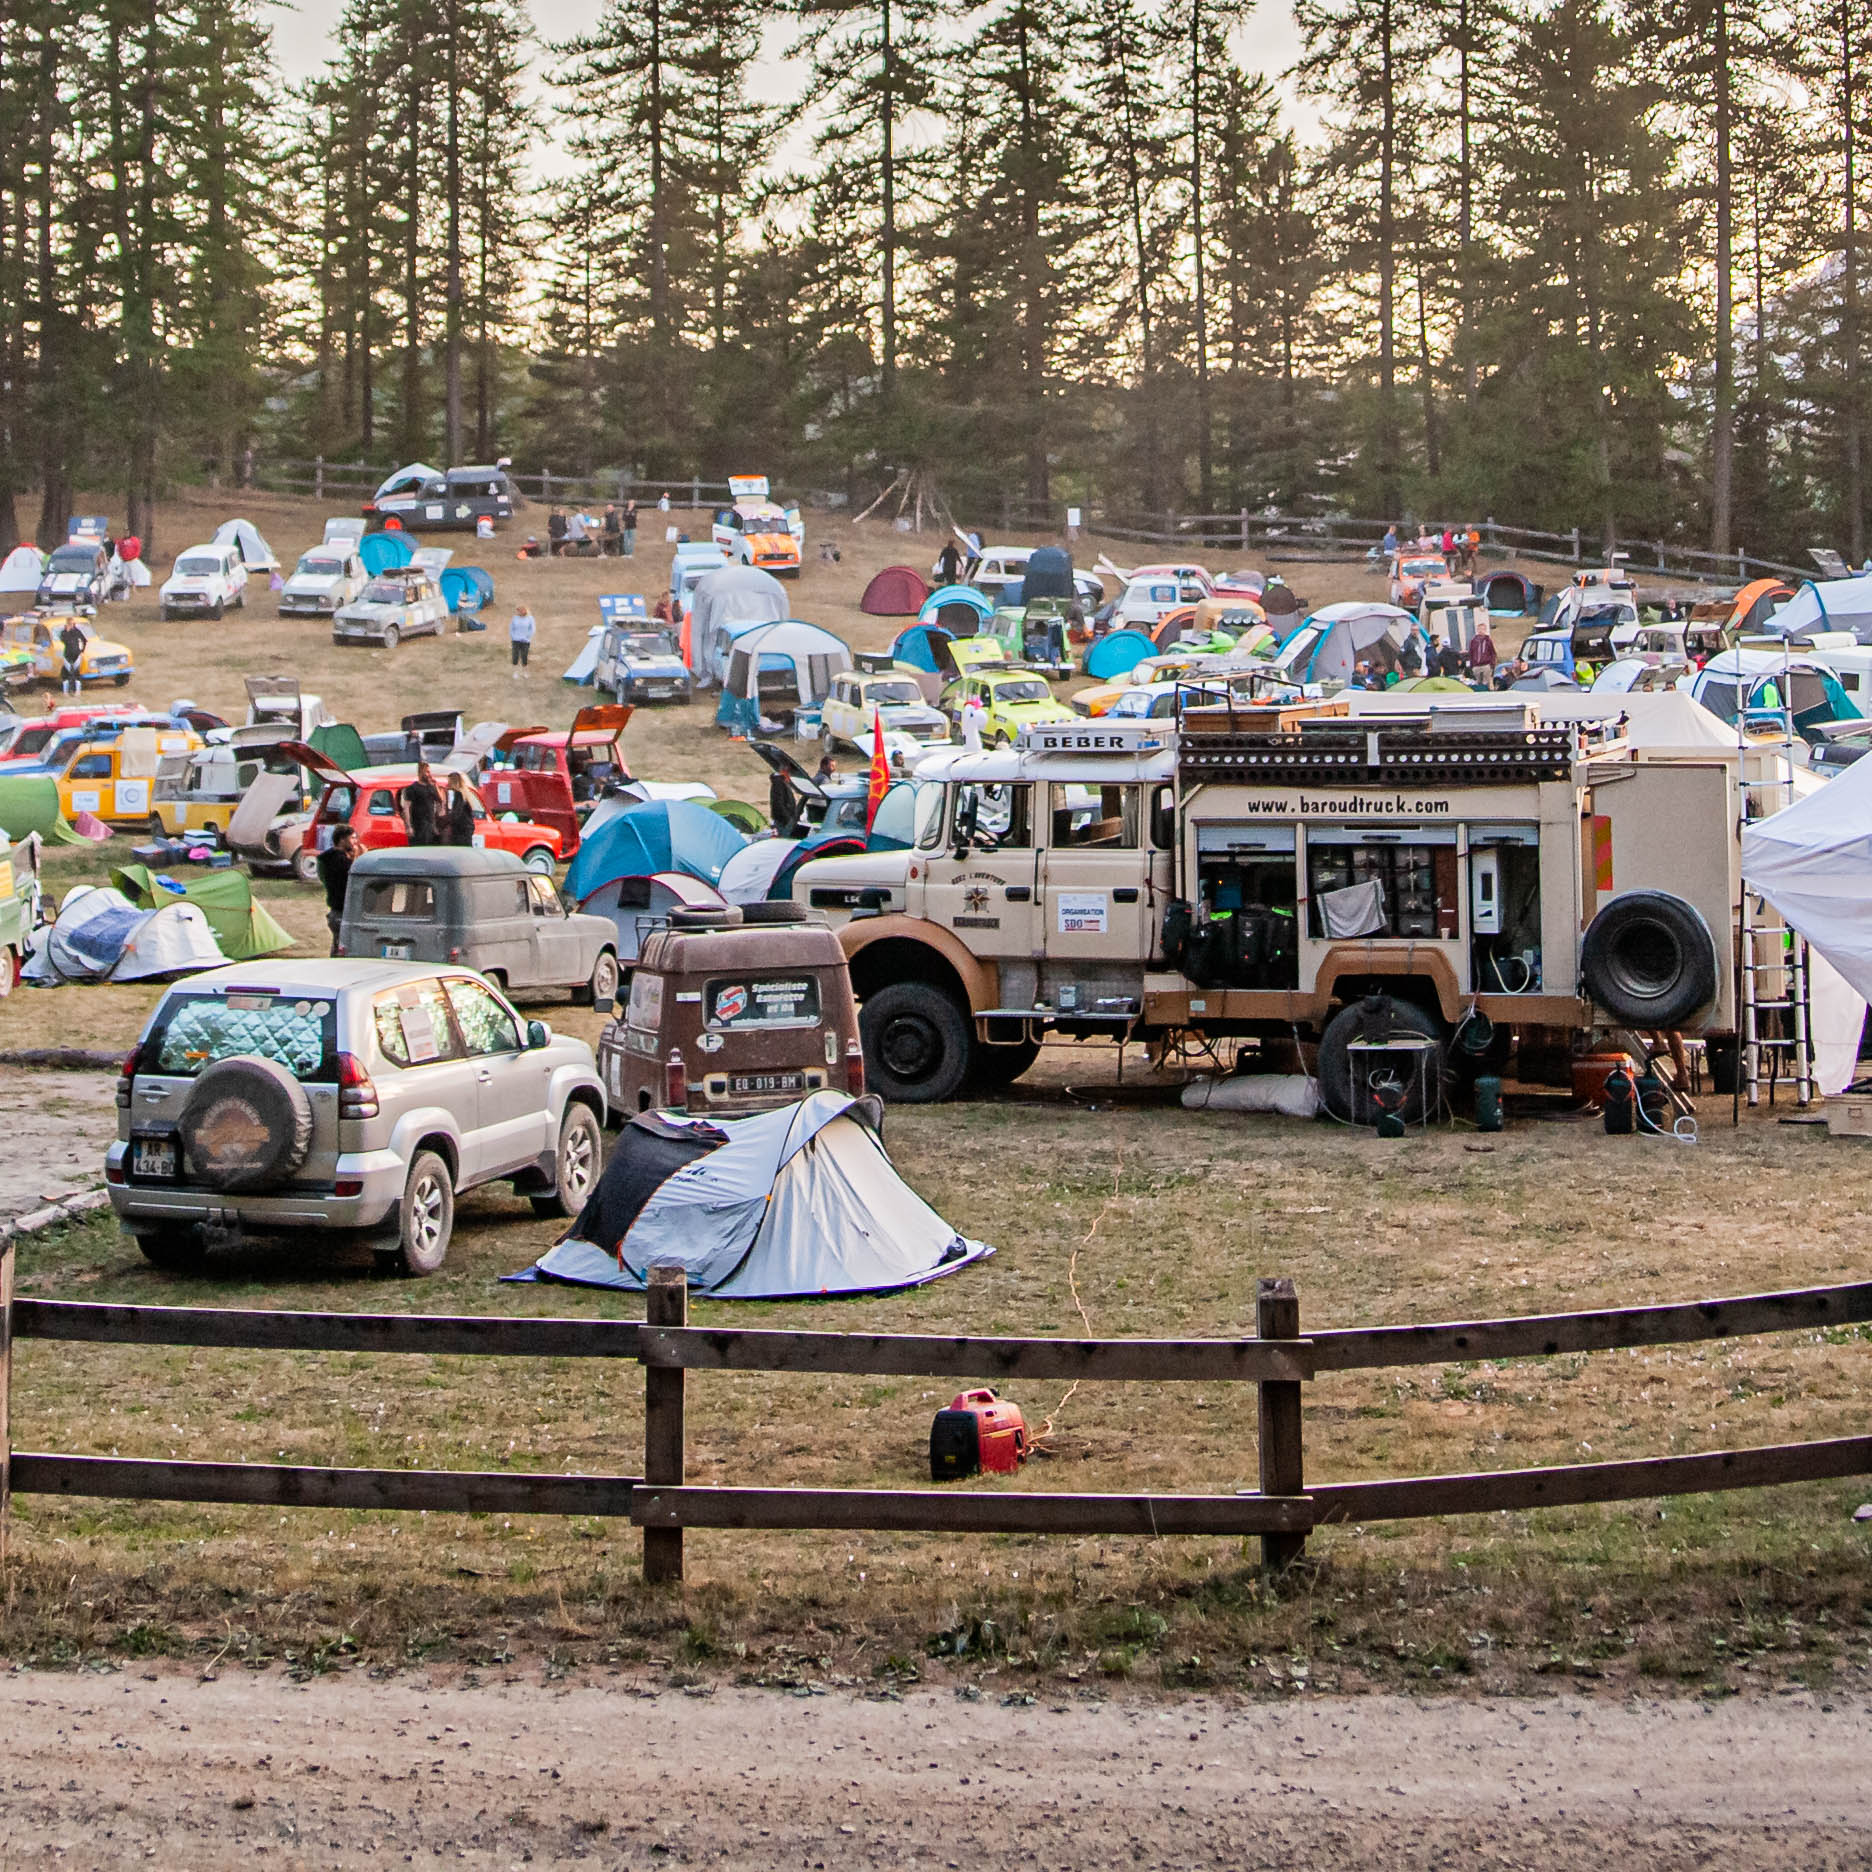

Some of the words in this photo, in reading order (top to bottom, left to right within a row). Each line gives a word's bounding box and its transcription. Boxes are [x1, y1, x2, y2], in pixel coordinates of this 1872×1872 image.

[1043, 736, 1125, 749] BEBER
[1248, 795, 1449, 814] www.baroudtruck.com
[1061, 908, 1105, 916] ORGANISATION
[1064, 918, 1083, 929] SDO
[705, 1034, 715, 1048] F
[146, 1145, 162, 1157] AR
